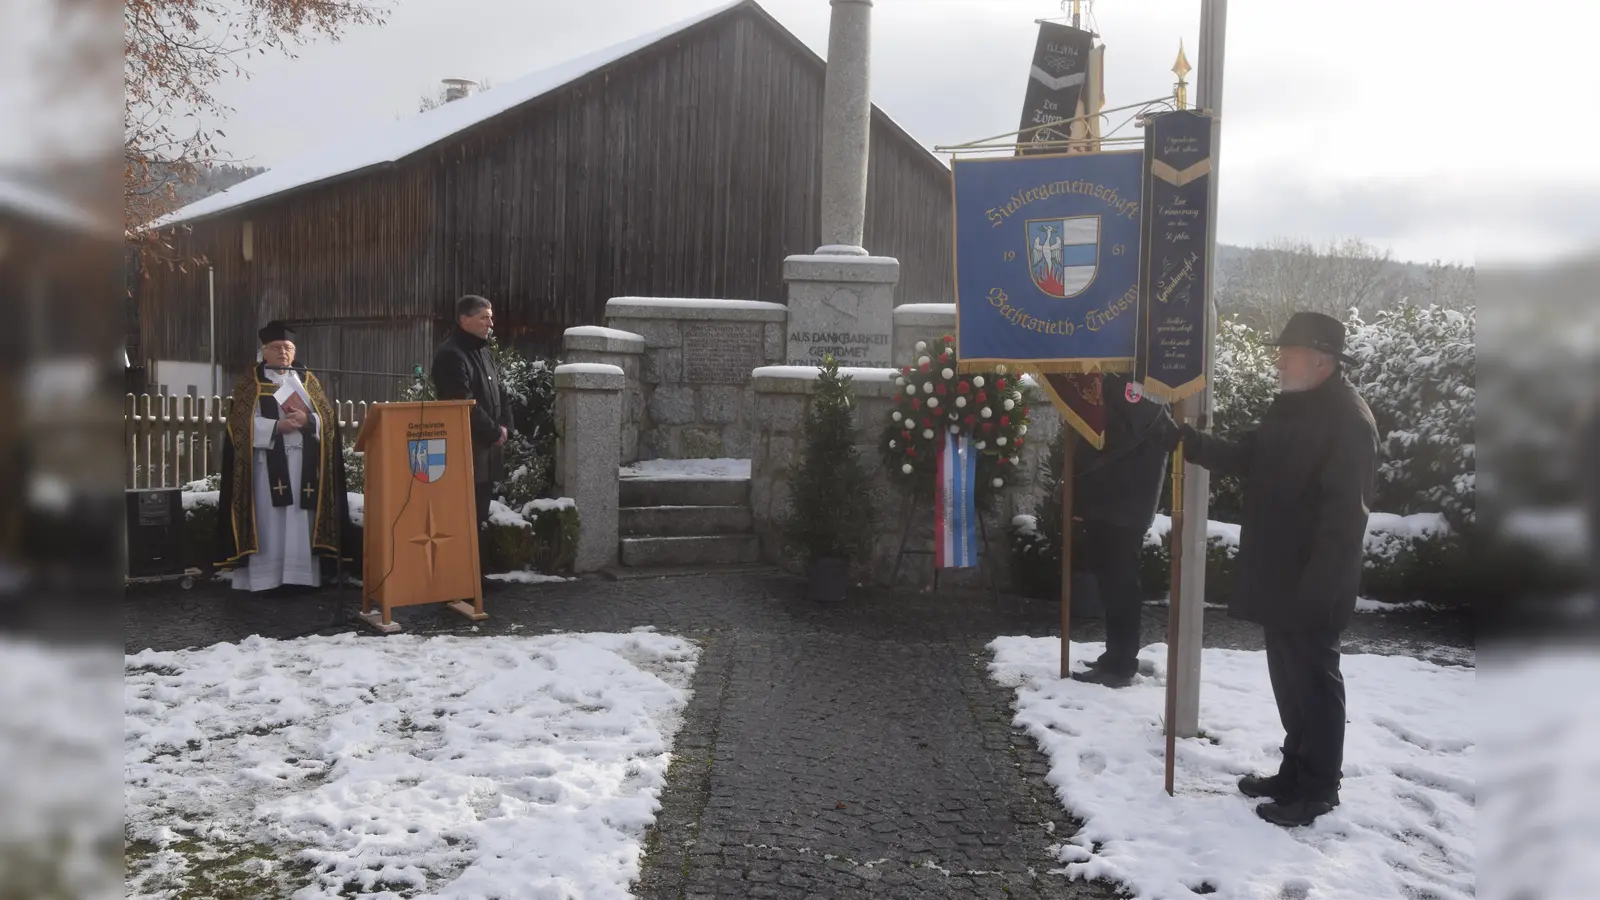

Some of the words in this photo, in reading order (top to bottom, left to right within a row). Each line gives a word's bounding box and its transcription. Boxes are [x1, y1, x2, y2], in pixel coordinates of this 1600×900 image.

[985, 178, 1139, 228] Siedlergemeinschaft
[1003, 250, 1016, 262] 19
[1112, 244, 1125, 256] 61
[790, 332, 810, 343] AUS
[812, 333, 890, 345] DANKBARKEIT
[808, 346, 870, 358] GEWIDMET
[408, 422, 445, 430] Gemeinde
